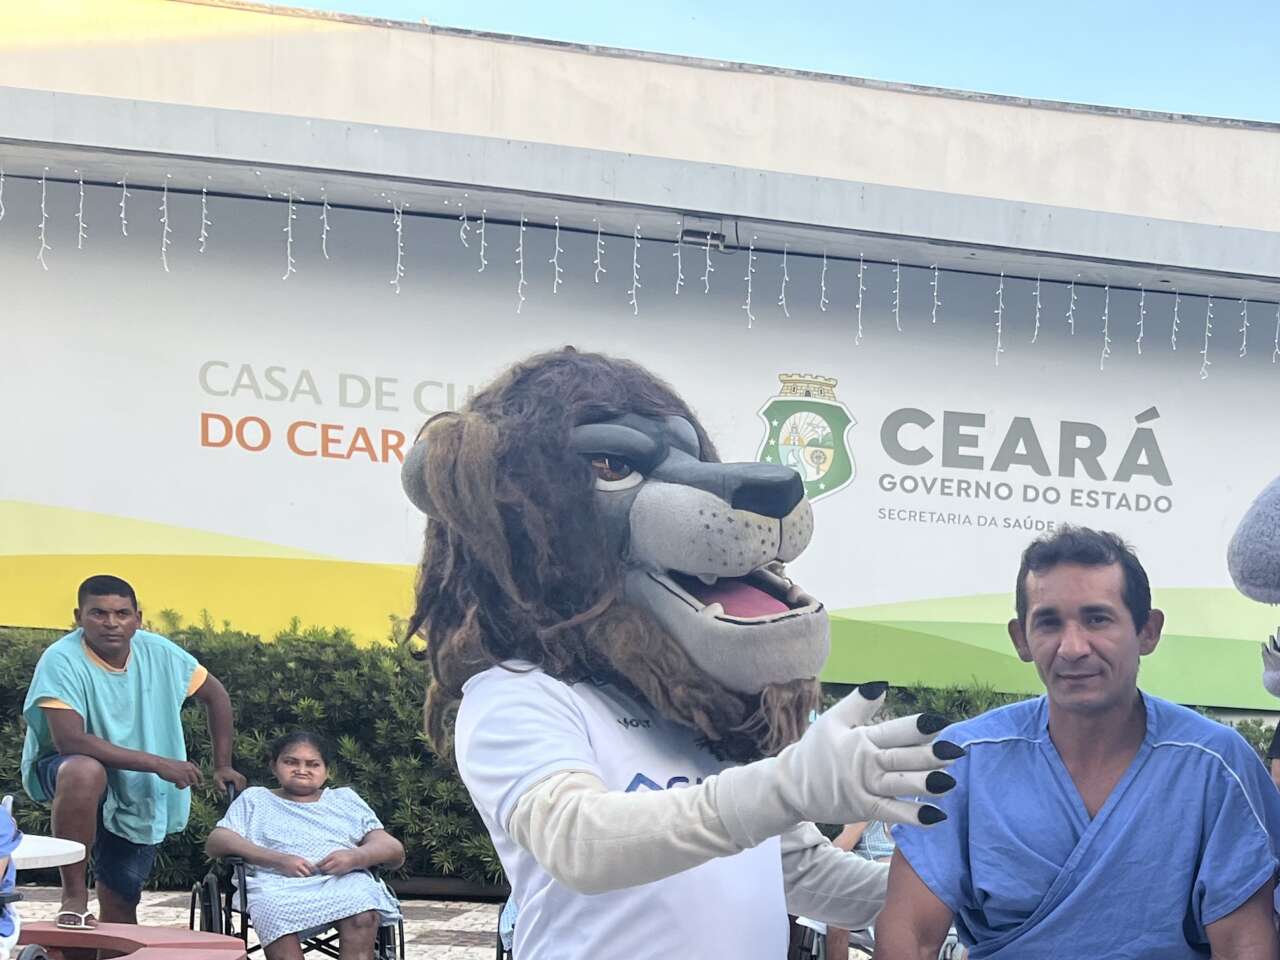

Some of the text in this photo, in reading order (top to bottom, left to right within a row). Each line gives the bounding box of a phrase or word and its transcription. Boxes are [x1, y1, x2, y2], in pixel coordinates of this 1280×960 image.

[199, 360, 322, 405] CASA
[338, 373, 399, 412] DE
[201, 412, 271, 452] DO
[880, 406, 1173, 487] CEARÁ
[878, 473, 1173, 513] GOVERNO DO ESTADO
[877, 508, 1055, 532] SECRETARIA DA SAÚDE
